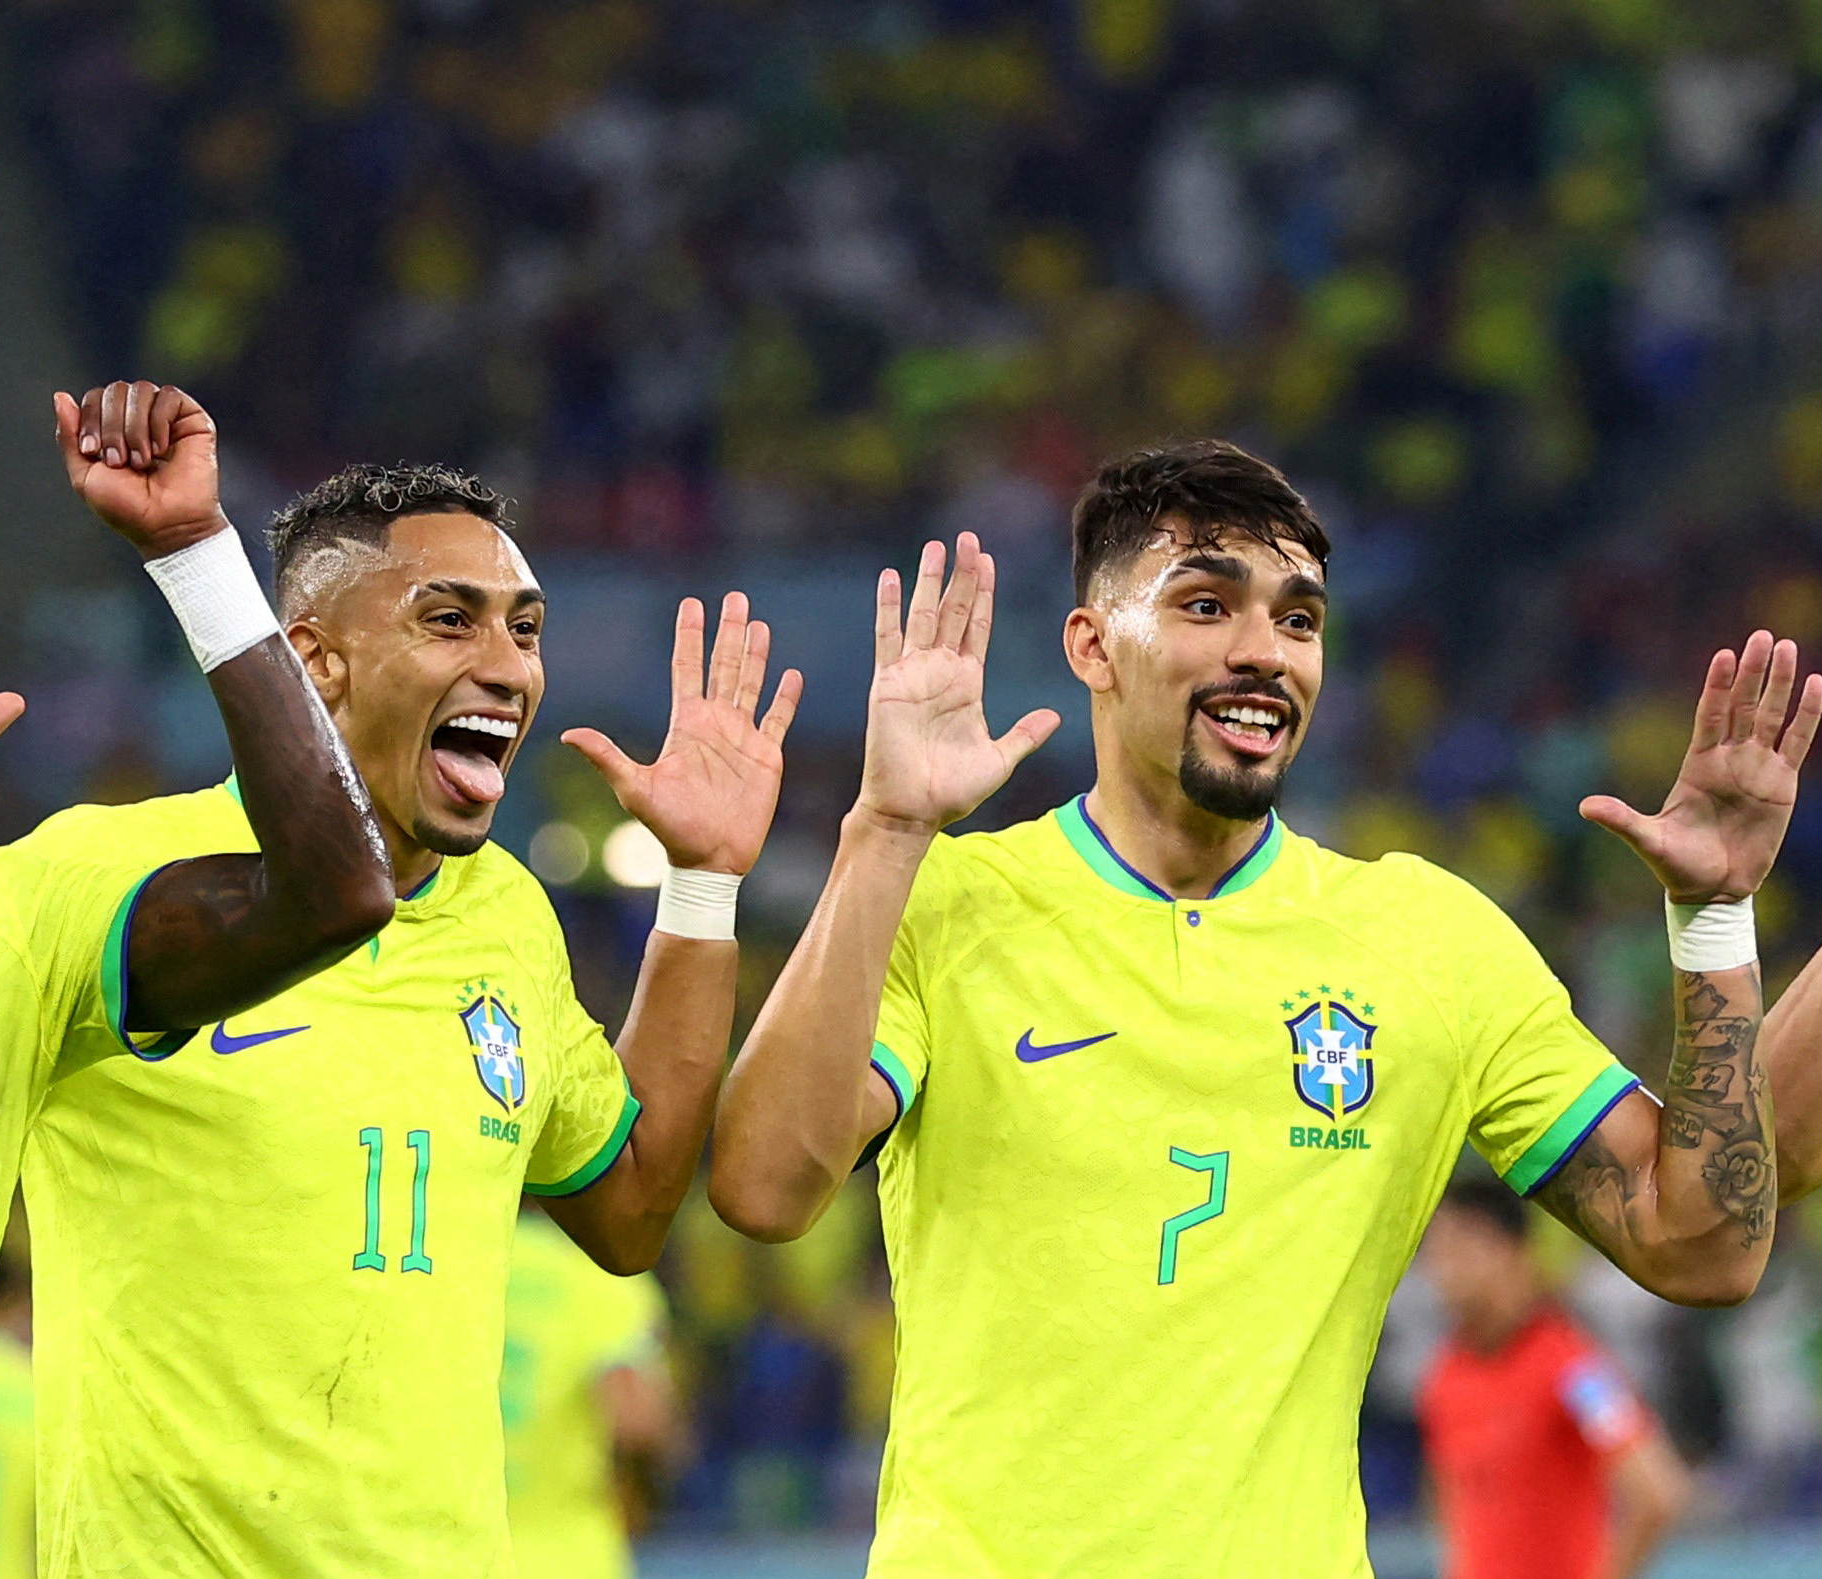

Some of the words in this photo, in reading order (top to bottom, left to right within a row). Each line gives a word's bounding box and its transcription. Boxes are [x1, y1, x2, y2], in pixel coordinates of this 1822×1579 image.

[487, 1043, 509, 1058] CBF
[1316, 1050, 1347, 1064] CBF
[479, 1115, 521, 1146] BRASI
[1289, 1126, 1372, 1150] BRASIL
[351, 1126, 433, 1276] 11
[1157, 1145, 1230, 1286] 7
